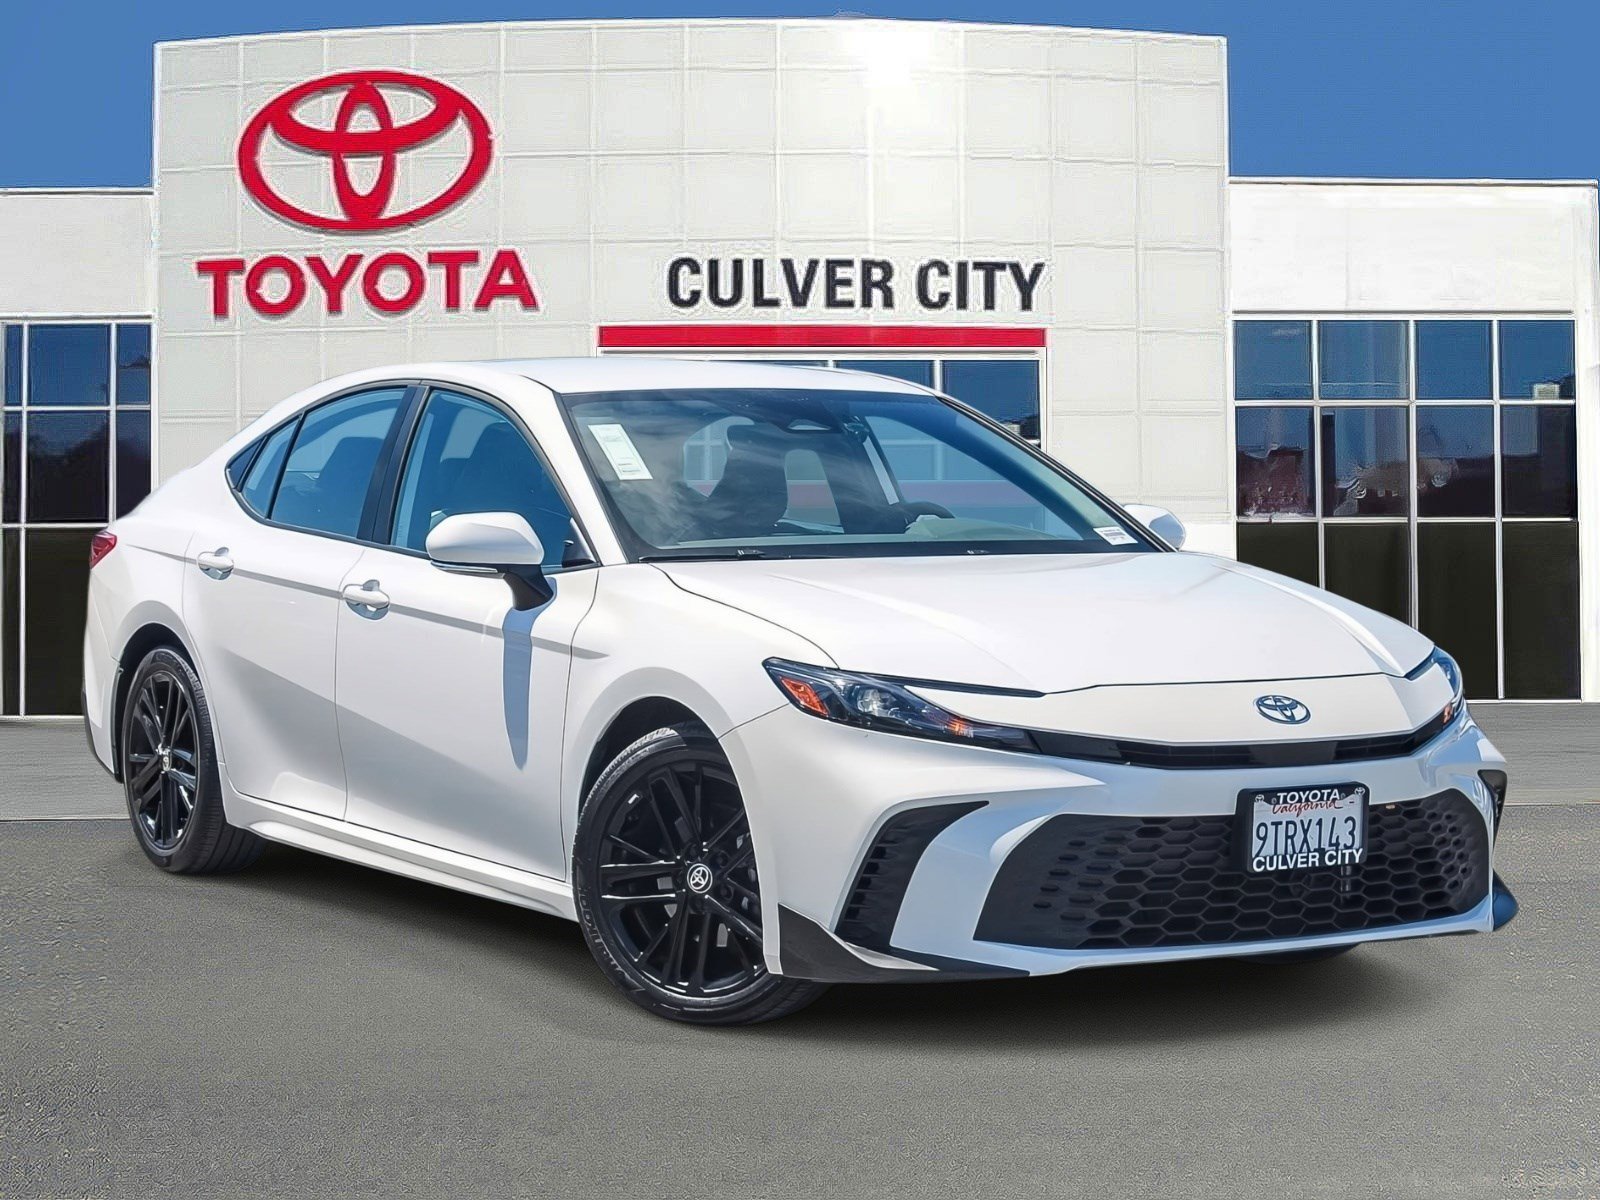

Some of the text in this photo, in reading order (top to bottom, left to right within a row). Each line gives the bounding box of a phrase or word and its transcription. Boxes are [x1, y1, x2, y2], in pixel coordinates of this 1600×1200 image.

[196, 249, 539, 319] TOYOTA
[667, 257, 1046, 311] CULVER CITY
[1271, 800, 1343, 817] California
[1277, 789, 1340, 804] TOYOTA
[1253, 816, 1356, 857] 9TRX143
[1253, 848, 1363, 872] CULVER CITY
